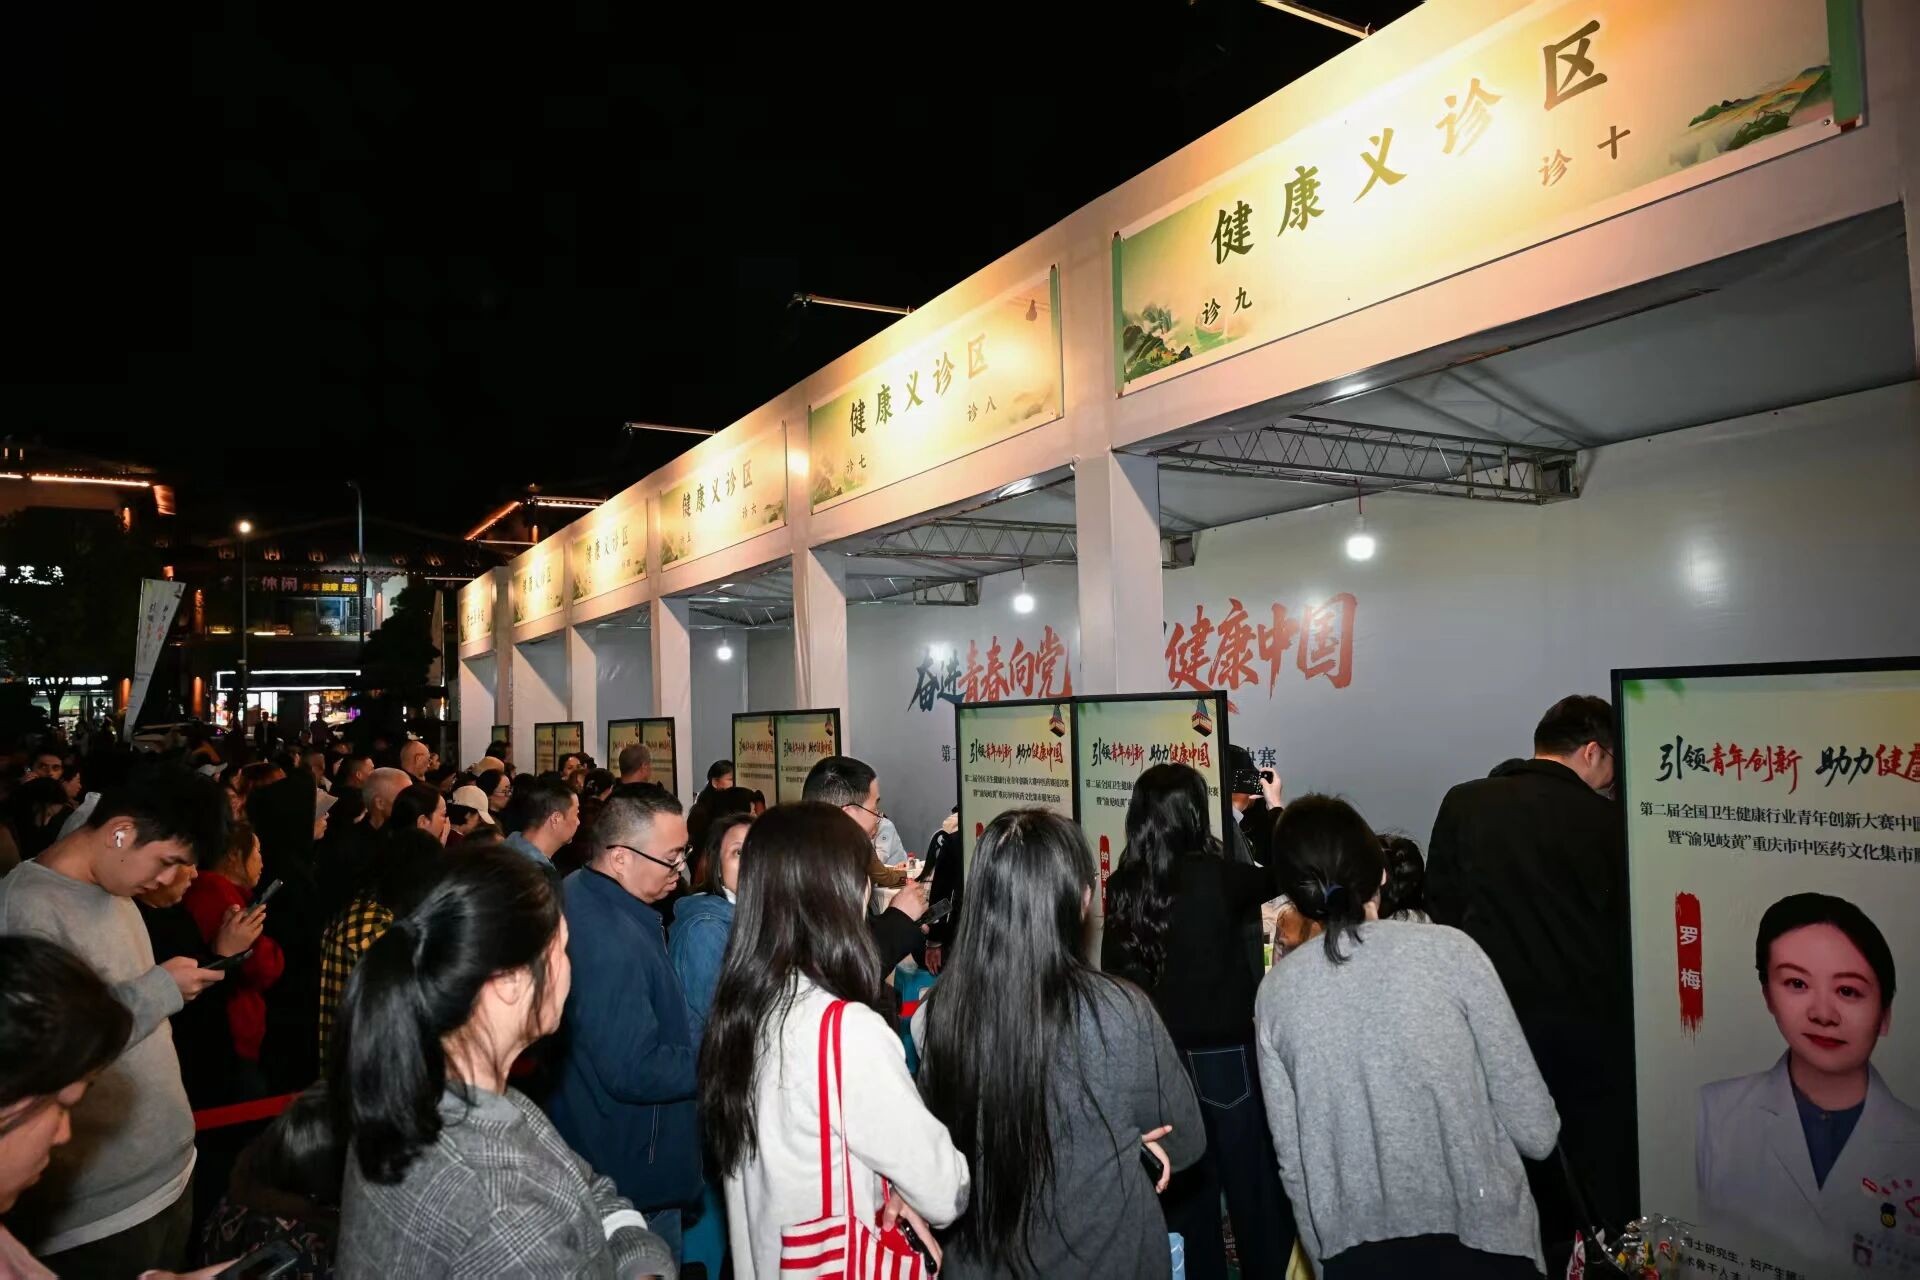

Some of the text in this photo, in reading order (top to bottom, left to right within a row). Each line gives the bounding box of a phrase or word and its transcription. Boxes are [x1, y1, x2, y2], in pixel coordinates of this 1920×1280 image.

[1211, 18, 1608, 265] 健康义诊区
[1539, 125, 1630, 187] 诊十
[1202, 286, 1253, 326] 诊九
[849, 333, 989, 438] 健康义诊区
[967, 396, 998, 424] 诊八
[682, 459, 753, 517] 健康义诊区
[1163, 592, 1358, 714] 健康中国
[969, 738, 1064, 772] 引领青年创新 助力健康中国
[1091, 737, 1145, 772] 引领青年创新
[1656, 735, 1803, 795] 引领青年创新
[1680, 925, 1701, 990] 罗梅
